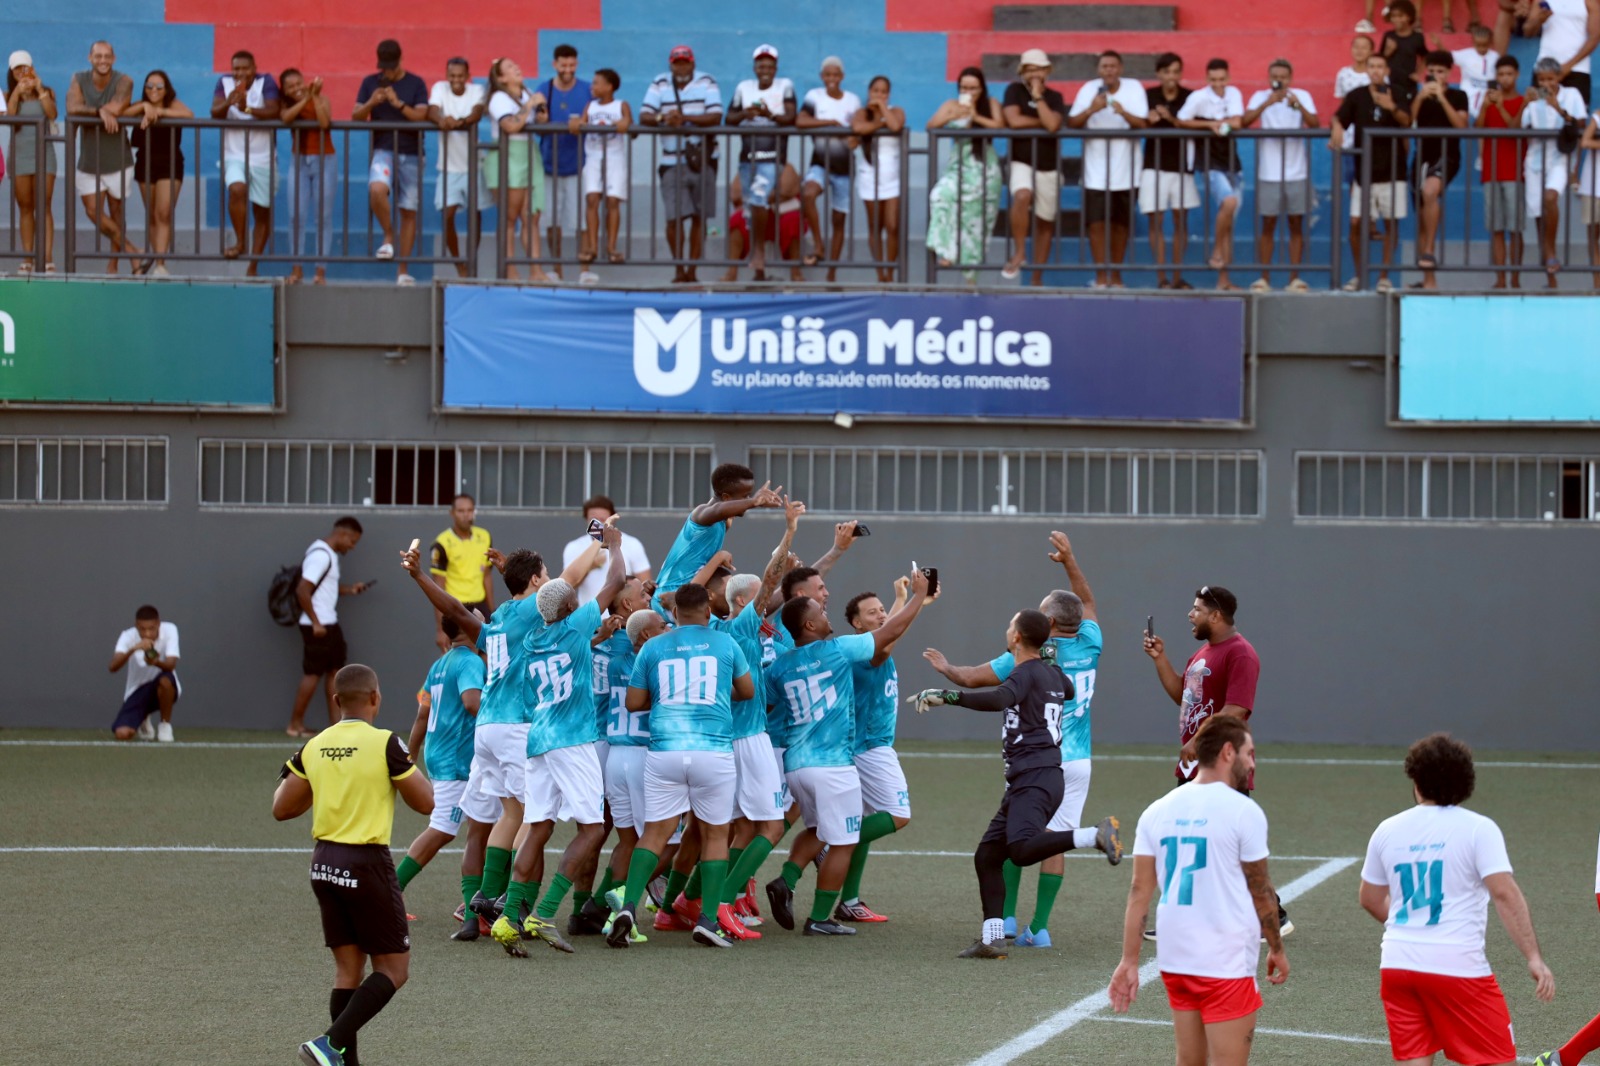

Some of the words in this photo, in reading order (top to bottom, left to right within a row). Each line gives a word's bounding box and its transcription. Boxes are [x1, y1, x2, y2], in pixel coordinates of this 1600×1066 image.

[711, 315, 859, 364] União
[867, 315, 1052, 367] Médica
[711, 369, 743, 387] Seu
[745, 370, 792, 390] plano
[793, 371, 814, 387] de
[816, 371, 865, 388] saúde
[867, 373, 893, 388] em
[894, 372, 940, 388] todos
[942, 375, 961, 389] os
[963, 374, 1051, 391] momentos
[529, 652, 573, 711] 26
[658, 656, 718, 706] 08
[784, 670, 837, 725] 05
[313, 863, 351, 878] GRUPO
[1160, 836, 1208, 906] 17
[1393, 860, 1445, 926] 14
